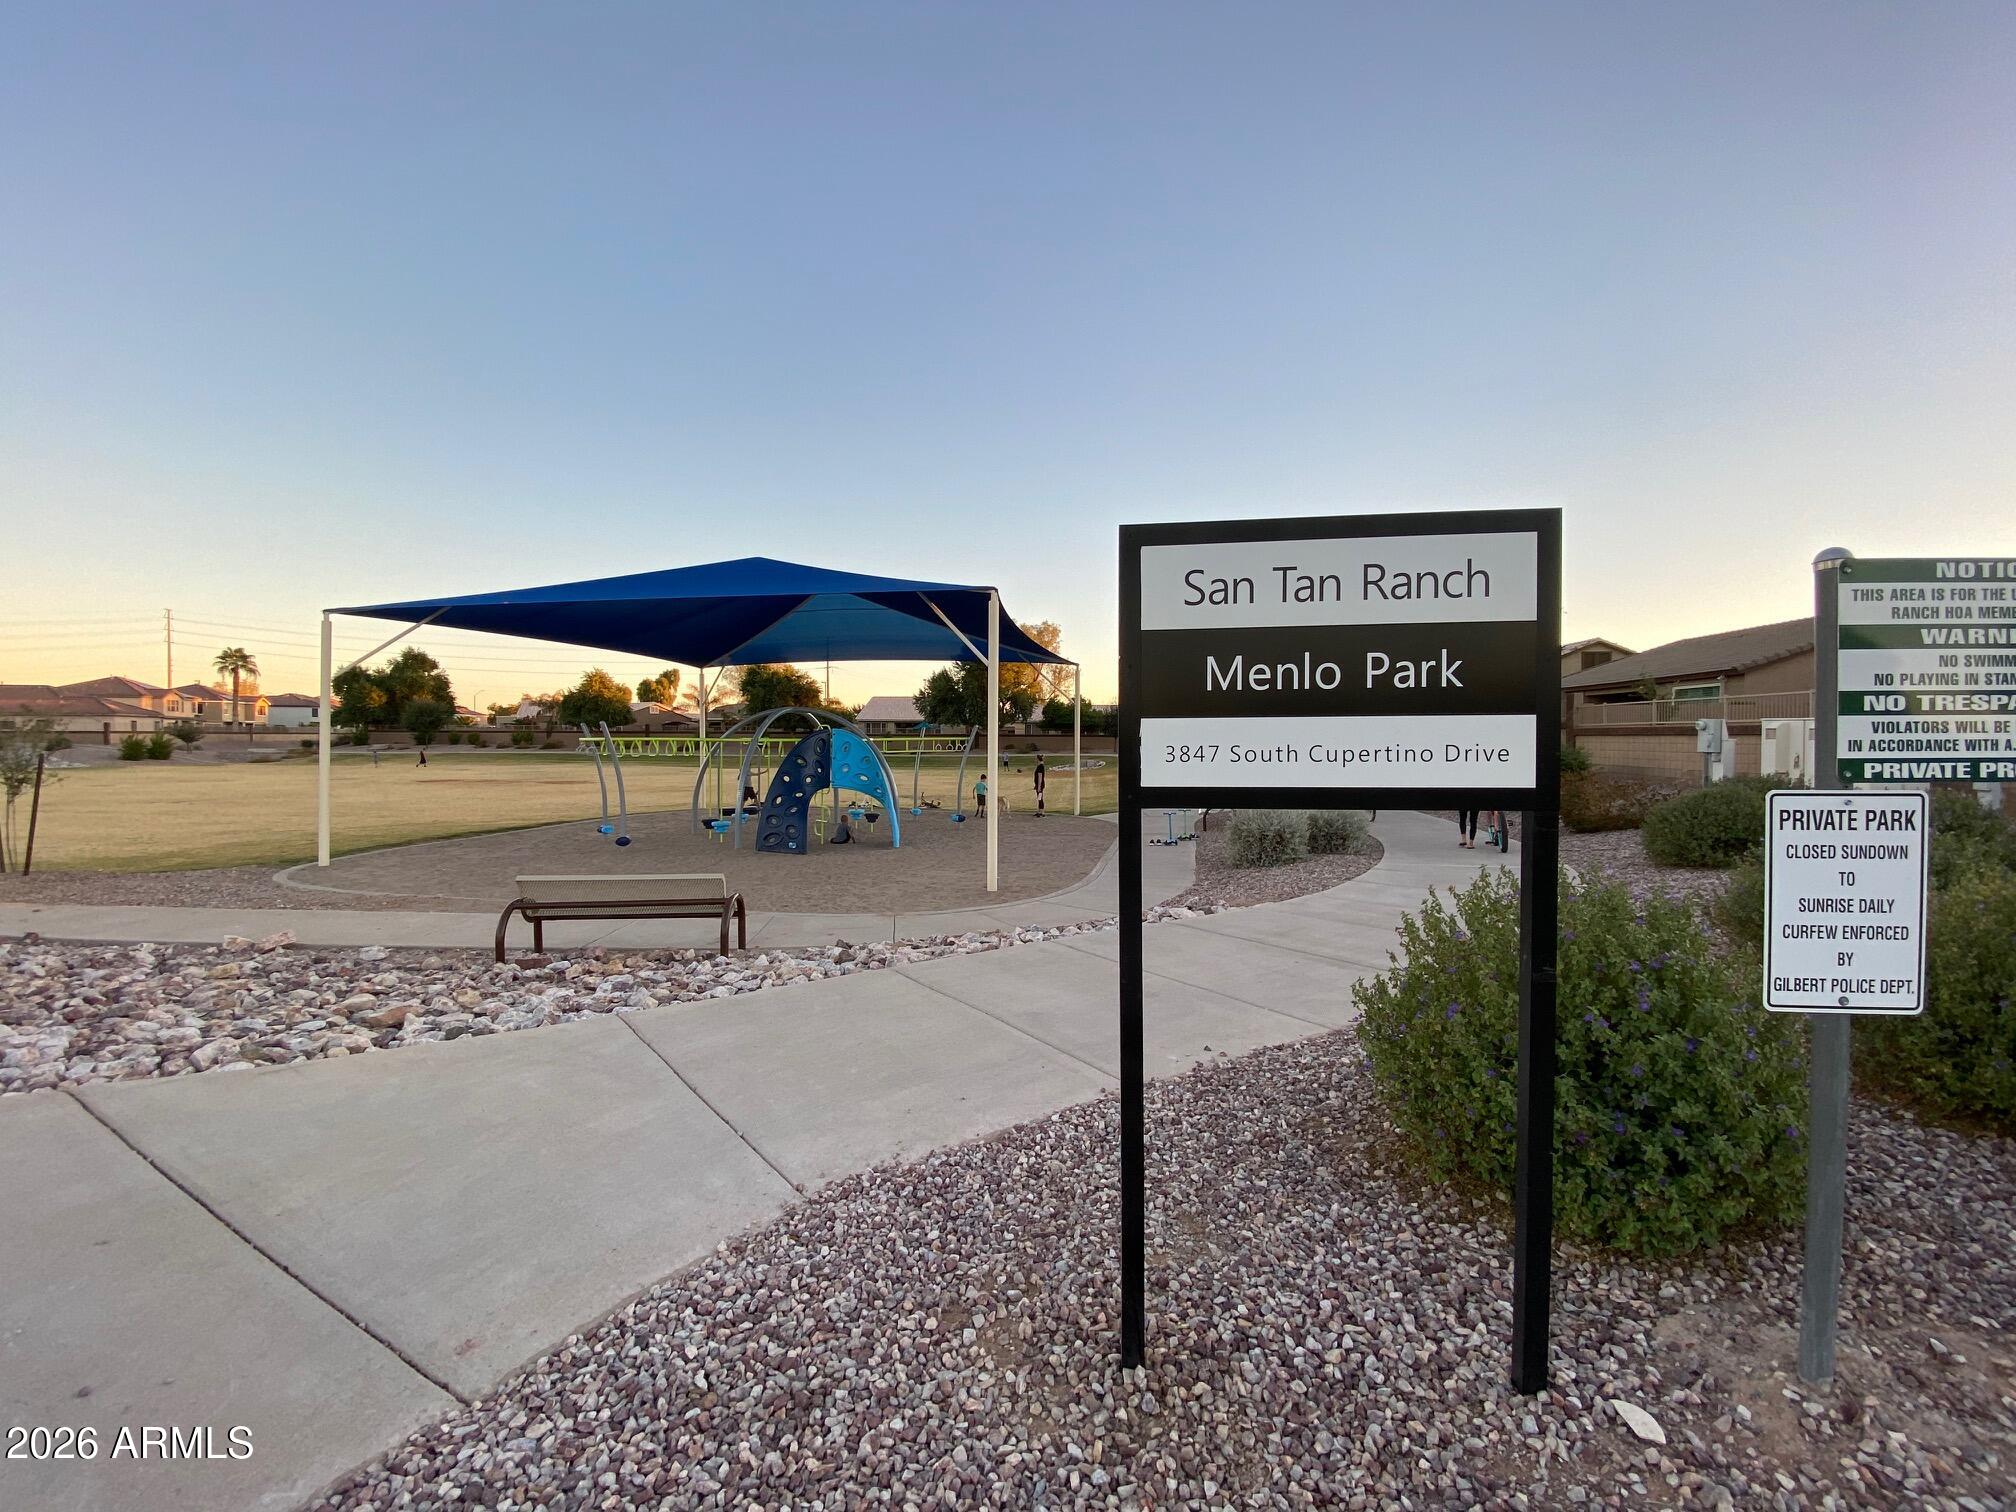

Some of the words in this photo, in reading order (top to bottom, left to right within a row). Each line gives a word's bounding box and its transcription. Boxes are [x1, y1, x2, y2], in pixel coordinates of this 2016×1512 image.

[1183, 569, 1254, 606] San
[1272, 566, 1341, 602] Tan
[1363, 558, 1490, 600] Ranch
[1852, 589, 1884, 601] THIS
[1890, 589, 1925, 601] AREA
[1931, 589, 1945, 600] IS
[1951, 588, 1976, 600] FOR
[1981, 588, 2006, 600] THE
[1892, 607, 1939, 619] RANCH
[1945, 607, 1972, 619] HOA
[1939, 655, 1958, 667] NO
[1206, 652, 1342, 691] Menlo
[1366, 649, 1464, 689] Park
[1874, 673, 1893, 686] NO
[1900, 673, 1959, 685] PLAYING
[1965, 673, 1979, 685] IN
[1863, 695, 1906, 711] NO
[1872, 721, 1949, 733] VIOLATORS
[1955, 721, 1988, 733] WILL
[1994, 721, 2010, 733] BE
[1848, 740, 1862, 752] IN
[1869, 739, 1959, 752] ACCORDANCE
[1965, 739, 1998, 751] WITH
[1165, 745, 1220, 763] 3847
[1230, 744, 1299, 764] South
[1309, 744, 1434, 767] Cupertino
[1445, 744, 1510, 763] Drive
[1863, 763, 1971, 779] PRIVATE
[1779, 810, 1858, 831] PRIVATE
[1865, 810, 1916, 831] PARK
[1786, 844, 1836, 859] CLOSED
[1841, 845, 1908, 860] SUNDOWN
[1839, 872, 1855, 886] TO
[1799, 898, 1854, 913] SUNRISE
[1859, 899, 1895, 913] DAILY
[1783, 924, 1837, 939] CURFEW
[1842, 926, 1909, 940] ENFORCED
[1838, 952, 1854, 966] BY
[1774, 977, 1826, 992] GILBERT
[1831, 979, 1875, 994] POLICE
[1880, 980, 1914, 994] DEPT.
